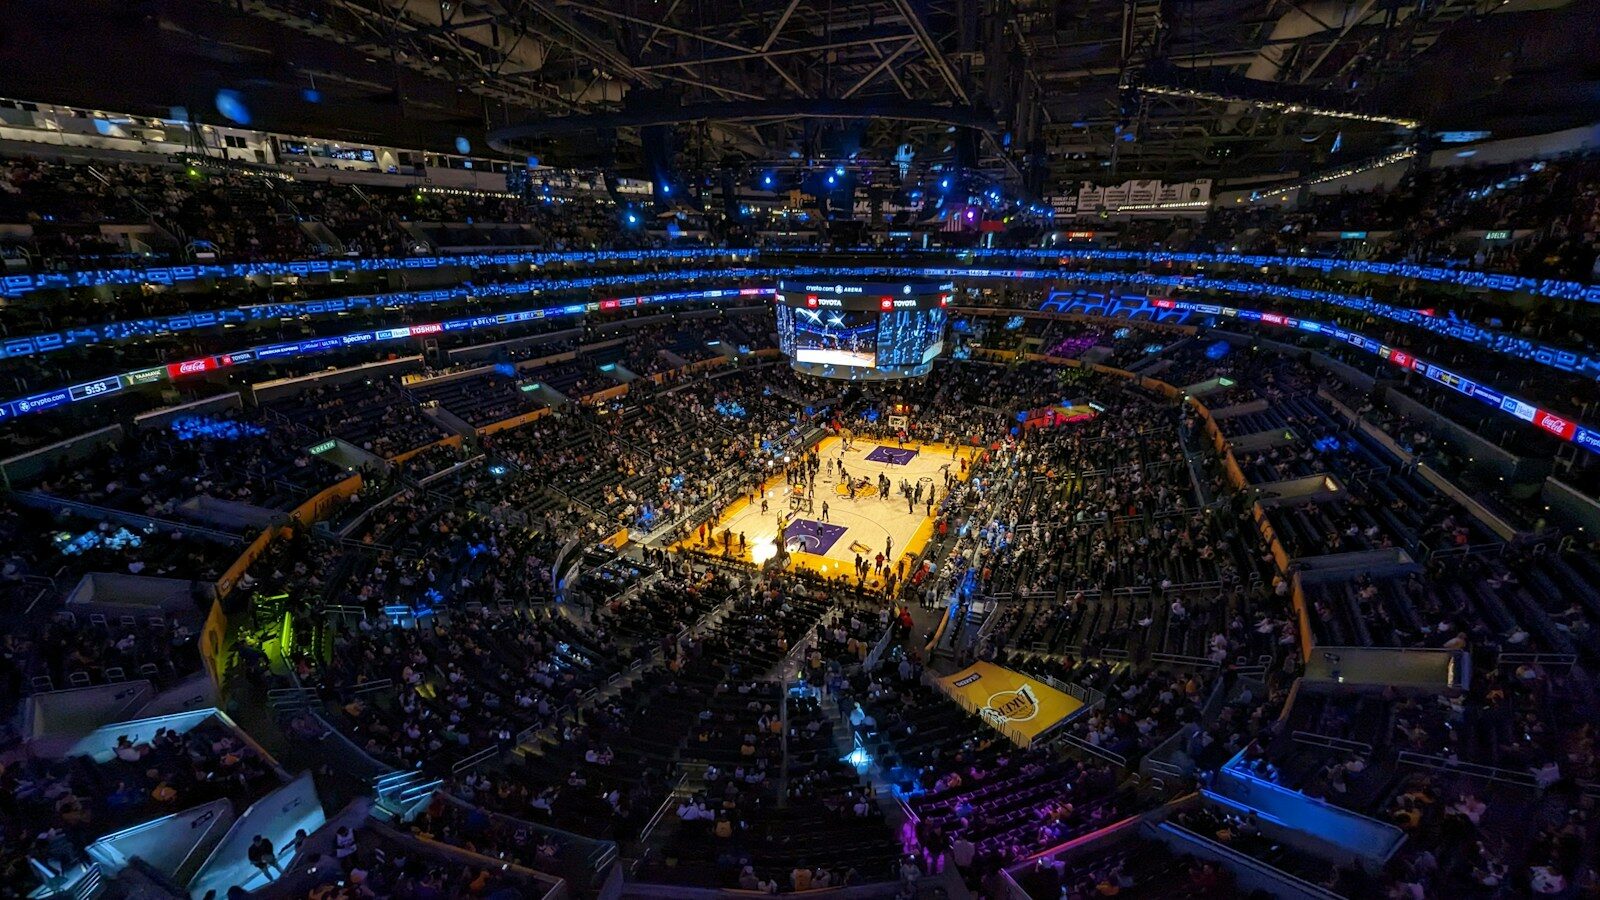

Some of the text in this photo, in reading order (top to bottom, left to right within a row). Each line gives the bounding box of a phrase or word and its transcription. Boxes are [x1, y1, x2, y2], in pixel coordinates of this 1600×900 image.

[817, 298, 842, 306] TOYOTA
[893, 299, 917, 307] TOYOTA
[477, 317, 496, 325] DELTA
[411, 324, 442, 335] TOSHIBA
[321, 339, 339, 347] ULTRA
[342, 333, 372, 344] Spectrum
[231, 353, 251, 362] TOYOTA
[85, 382, 107, 394] 5:53
[30, 393, 66, 408] crypto.com
[315, 442, 335, 452] DELTA
